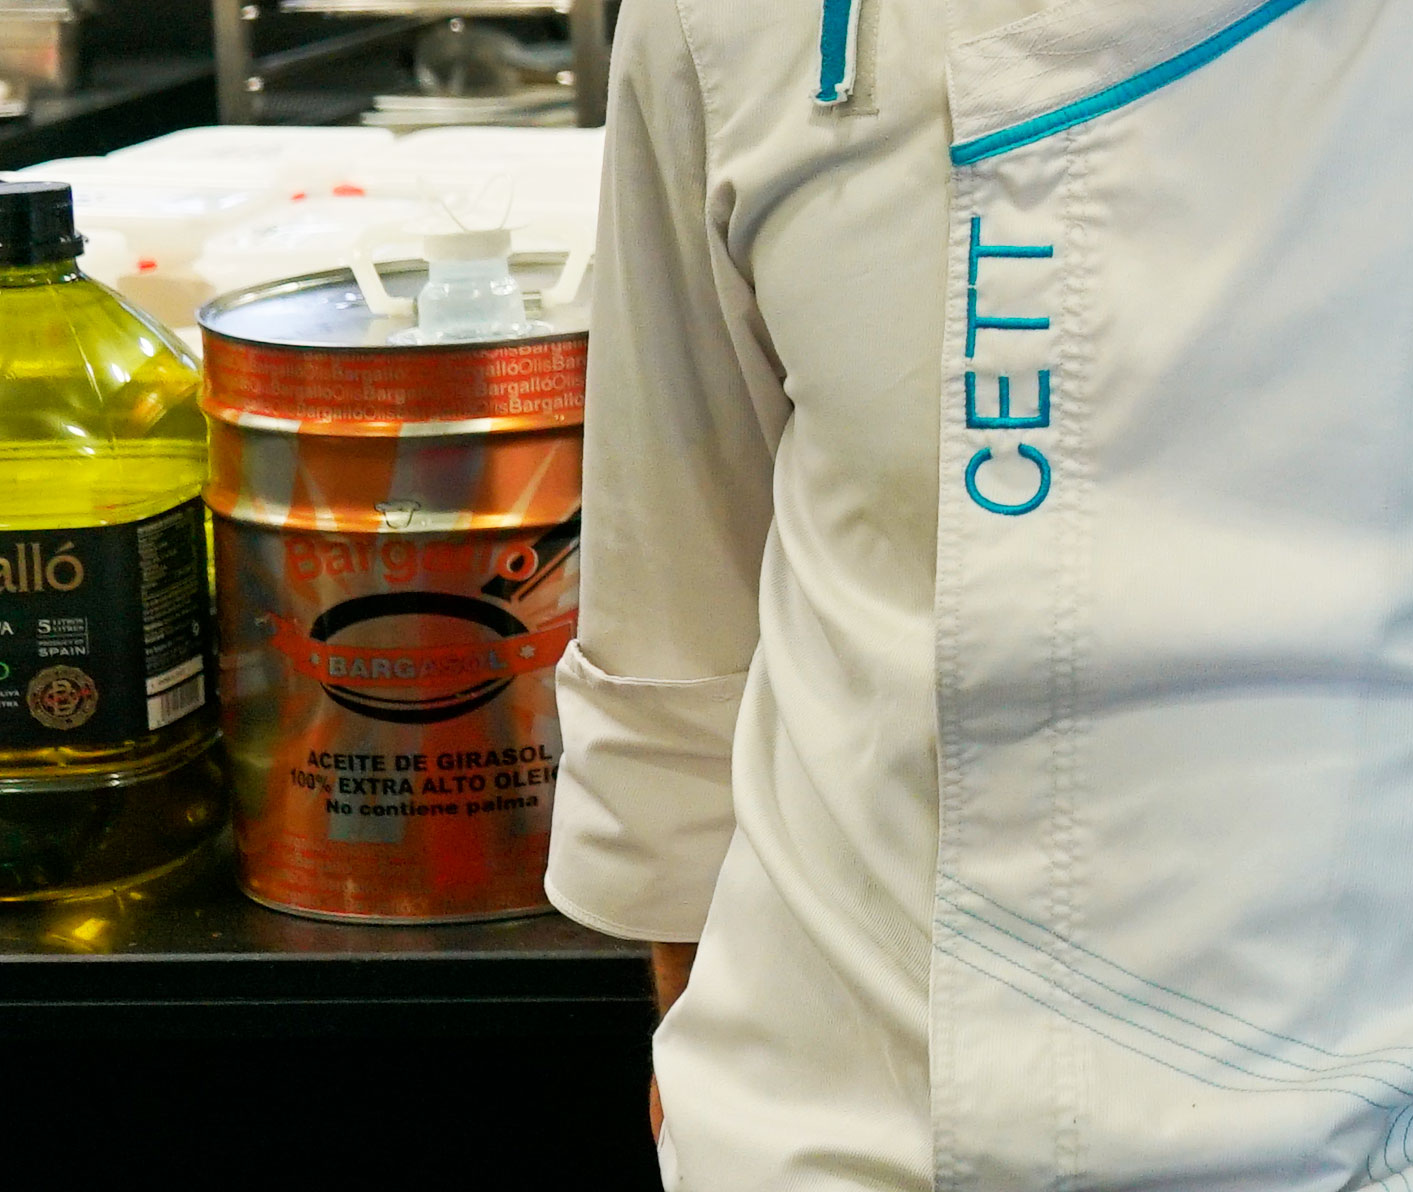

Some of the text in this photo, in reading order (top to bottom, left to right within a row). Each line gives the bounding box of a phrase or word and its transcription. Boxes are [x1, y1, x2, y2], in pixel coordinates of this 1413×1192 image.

[965, 216, 1053, 516] CETT
[37, 619, 51, 634] 5
[38, 646, 86, 657] SPAIN
[307, 744, 552, 772] ACEITE DE GIRASOL
[290, 767, 332, 793] 100%
[338, 776, 414, 795] EXTRA
[422, 774, 486, 794] ALTO
[326, 793, 539, 818] No contiene palma
